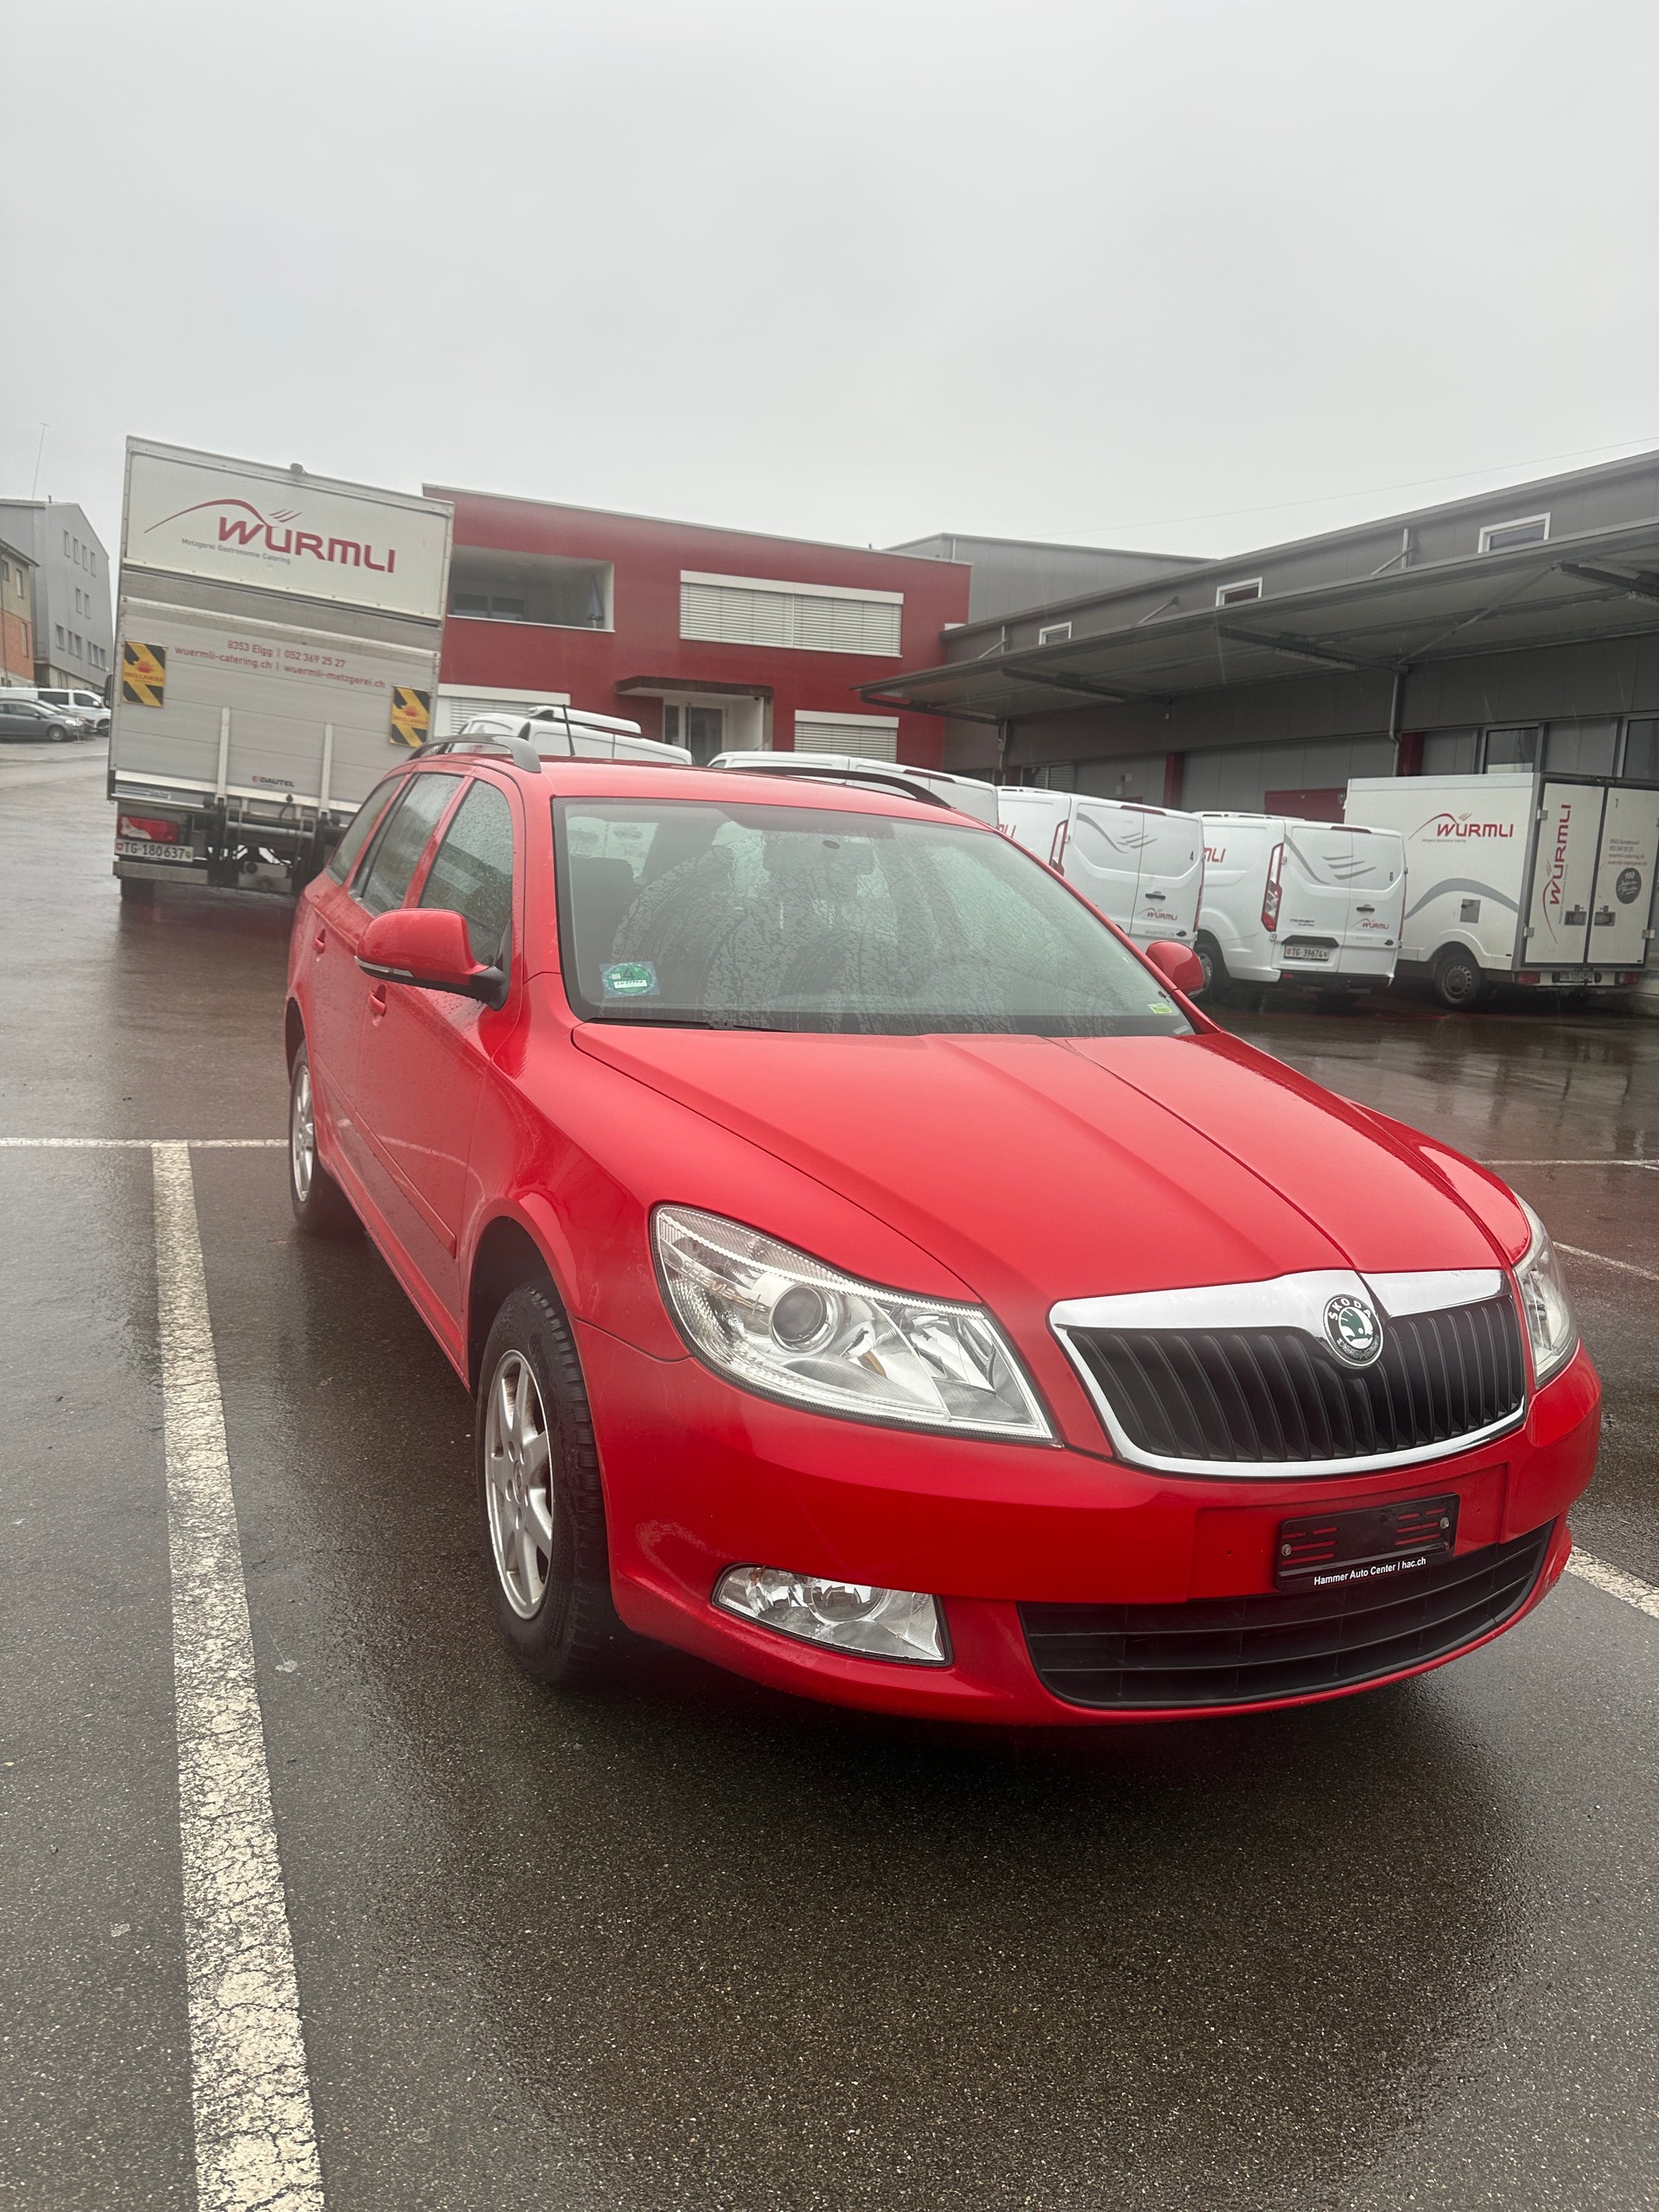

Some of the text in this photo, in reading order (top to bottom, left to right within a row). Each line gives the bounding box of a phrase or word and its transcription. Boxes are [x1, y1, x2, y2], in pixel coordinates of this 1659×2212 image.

[262, 552, 291, 565] Catering
[1313, 1572, 1349, 1586] Hammer
[1350, 1568, 1369, 1580] Auto
[1370, 1564, 1395, 1575] Center
[1402, 1556, 1427, 1569] hac.ch
